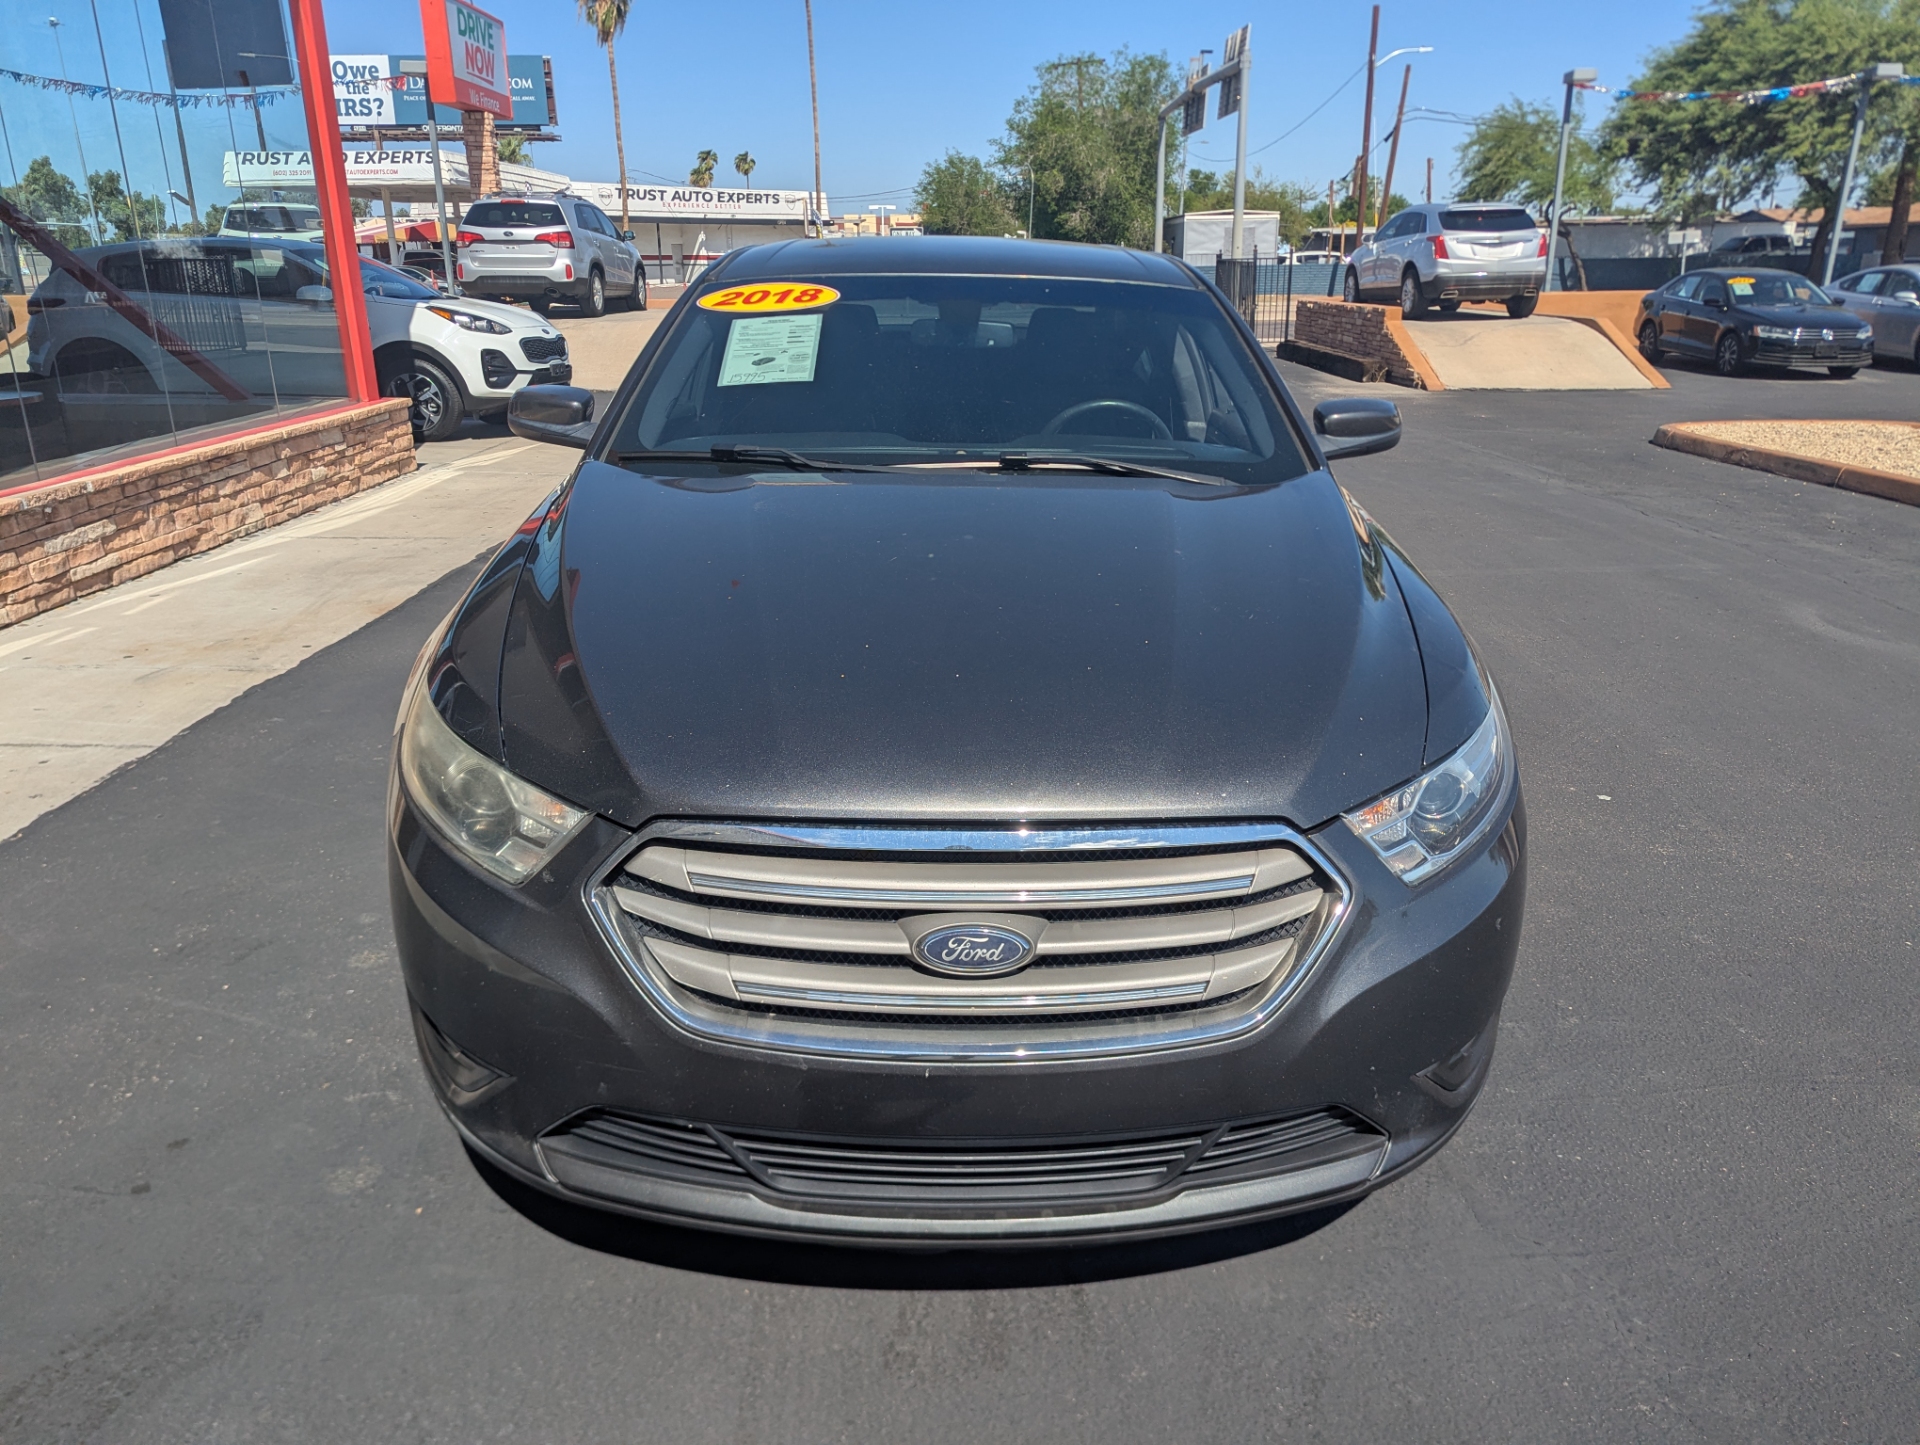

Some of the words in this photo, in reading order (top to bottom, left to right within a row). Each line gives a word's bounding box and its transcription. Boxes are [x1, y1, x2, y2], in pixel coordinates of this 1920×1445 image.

[456, 6, 495, 51] DRIVE
[465, 40, 495, 80] NOW
[332, 60, 380, 80] Owe
[346, 82, 370, 95] the
[335, 97, 384, 117] IRS?
[469, 88, 480, 107] We
[480, 91, 500, 113] Finance
[234, 152, 294, 166] TRUST
[353, 150, 435, 165] EXPERTS
[272, 169, 288, 177] (602)
[614, 187, 668, 202] TRUST
[670, 190, 714, 203] AUTO
[717, 191, 780, 205] EXPERTS
[662, 201, 710, 209] EXPERIENCE
[714, 202, 742, 210] BETTER
[711, 288, 824, 307] 2018
[941, 936, 1005, 961] Ford
